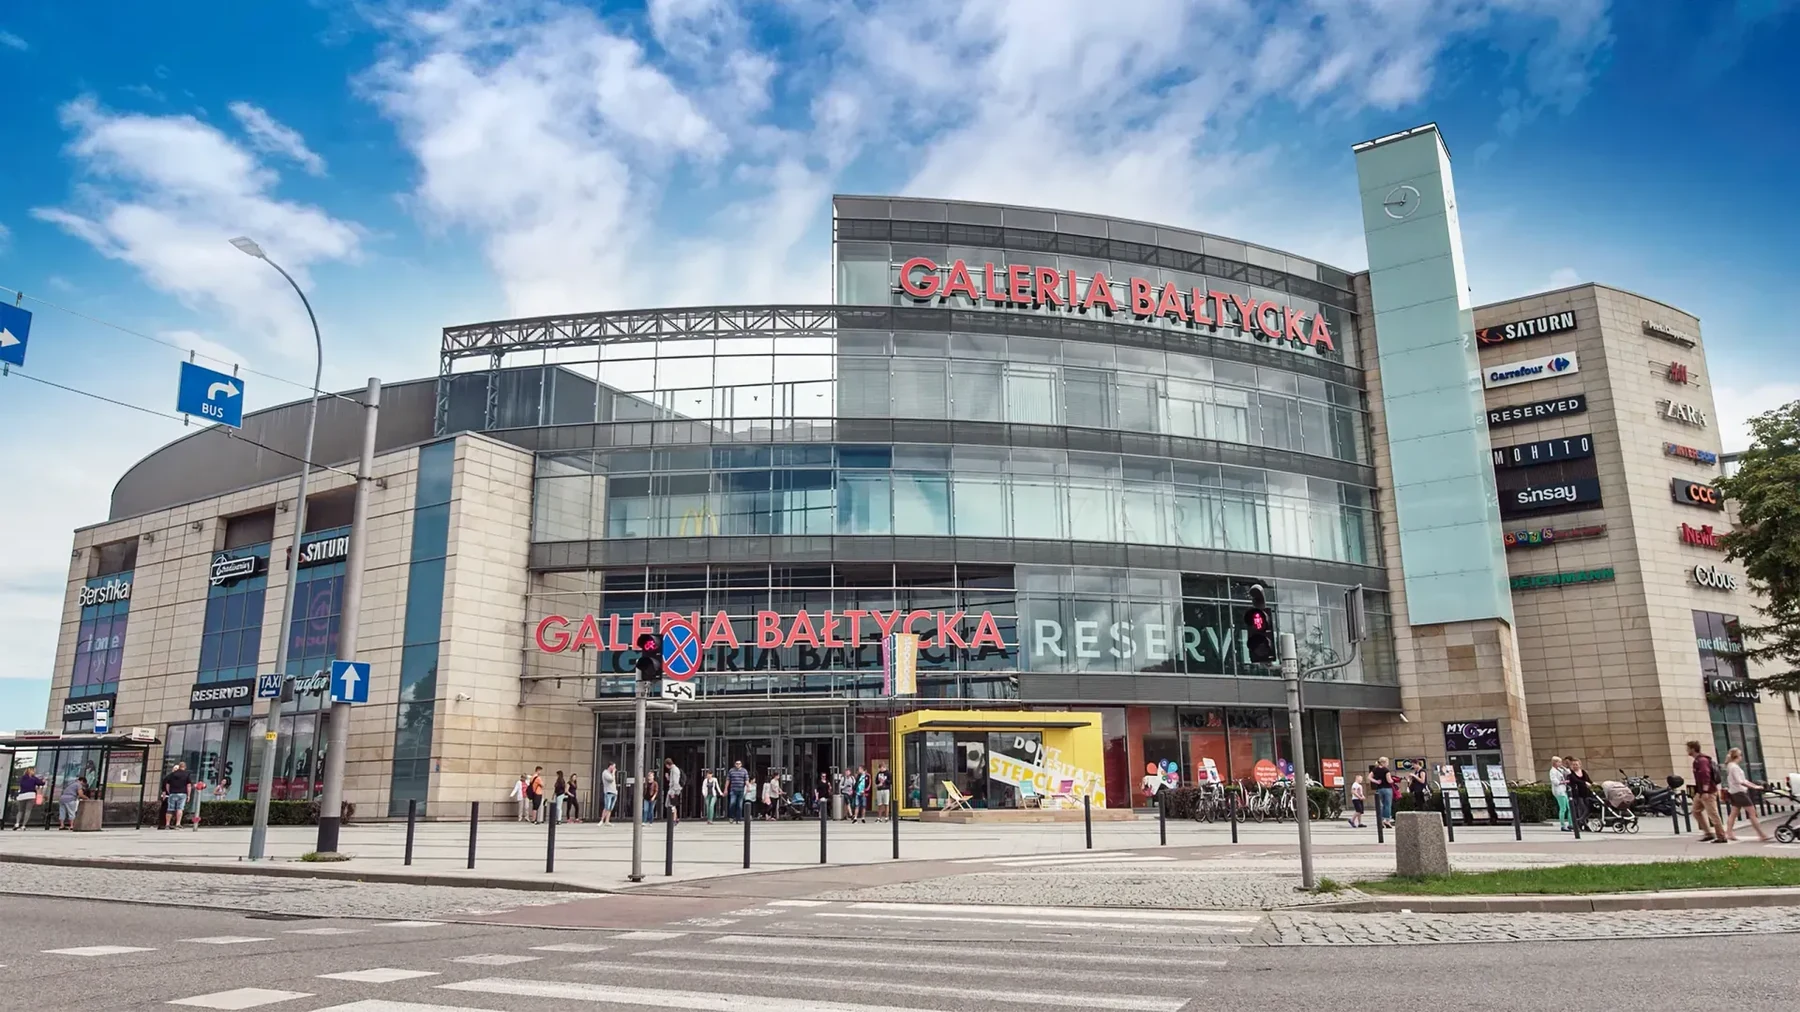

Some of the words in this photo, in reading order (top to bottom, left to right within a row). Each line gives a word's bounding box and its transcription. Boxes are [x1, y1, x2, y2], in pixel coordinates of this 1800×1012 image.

[900, 257, 1118, 311] GALERIA
[1130, 277, 1335, 351] BAŁTYCKA
[1505, 312, 1575, 340] SATURN
[1490, 365, 1543, 382] Carrefour
[201, 402, 224, 418] BUS
[1491, 399, 1579, 423] RESERVED
[1666, 400, 1708, 427] ZARA
[1494, 437, 1589, 465] MOHITO
[1517, 485, 1577, 505] sinsay
[1690, 483, 1716, 504] CCC
[1510, 567, 1615, 588] DEICHMANN
[1694, 564, 1737, 591] Cubus
[79, 579, 129, 607] Bershka
[757, 609, 1006, 649] BAŁTYCKA
[1034, 619, 1281, 667] RESERV
[1697, 637, 1741, 653] medicine
[261, 675, 282, 689] TAXI
[192, 686, 248, 702] RESERVED
[64, 700, 110, 714] RESERVED
[1468, 739, 1477, 747] 4
